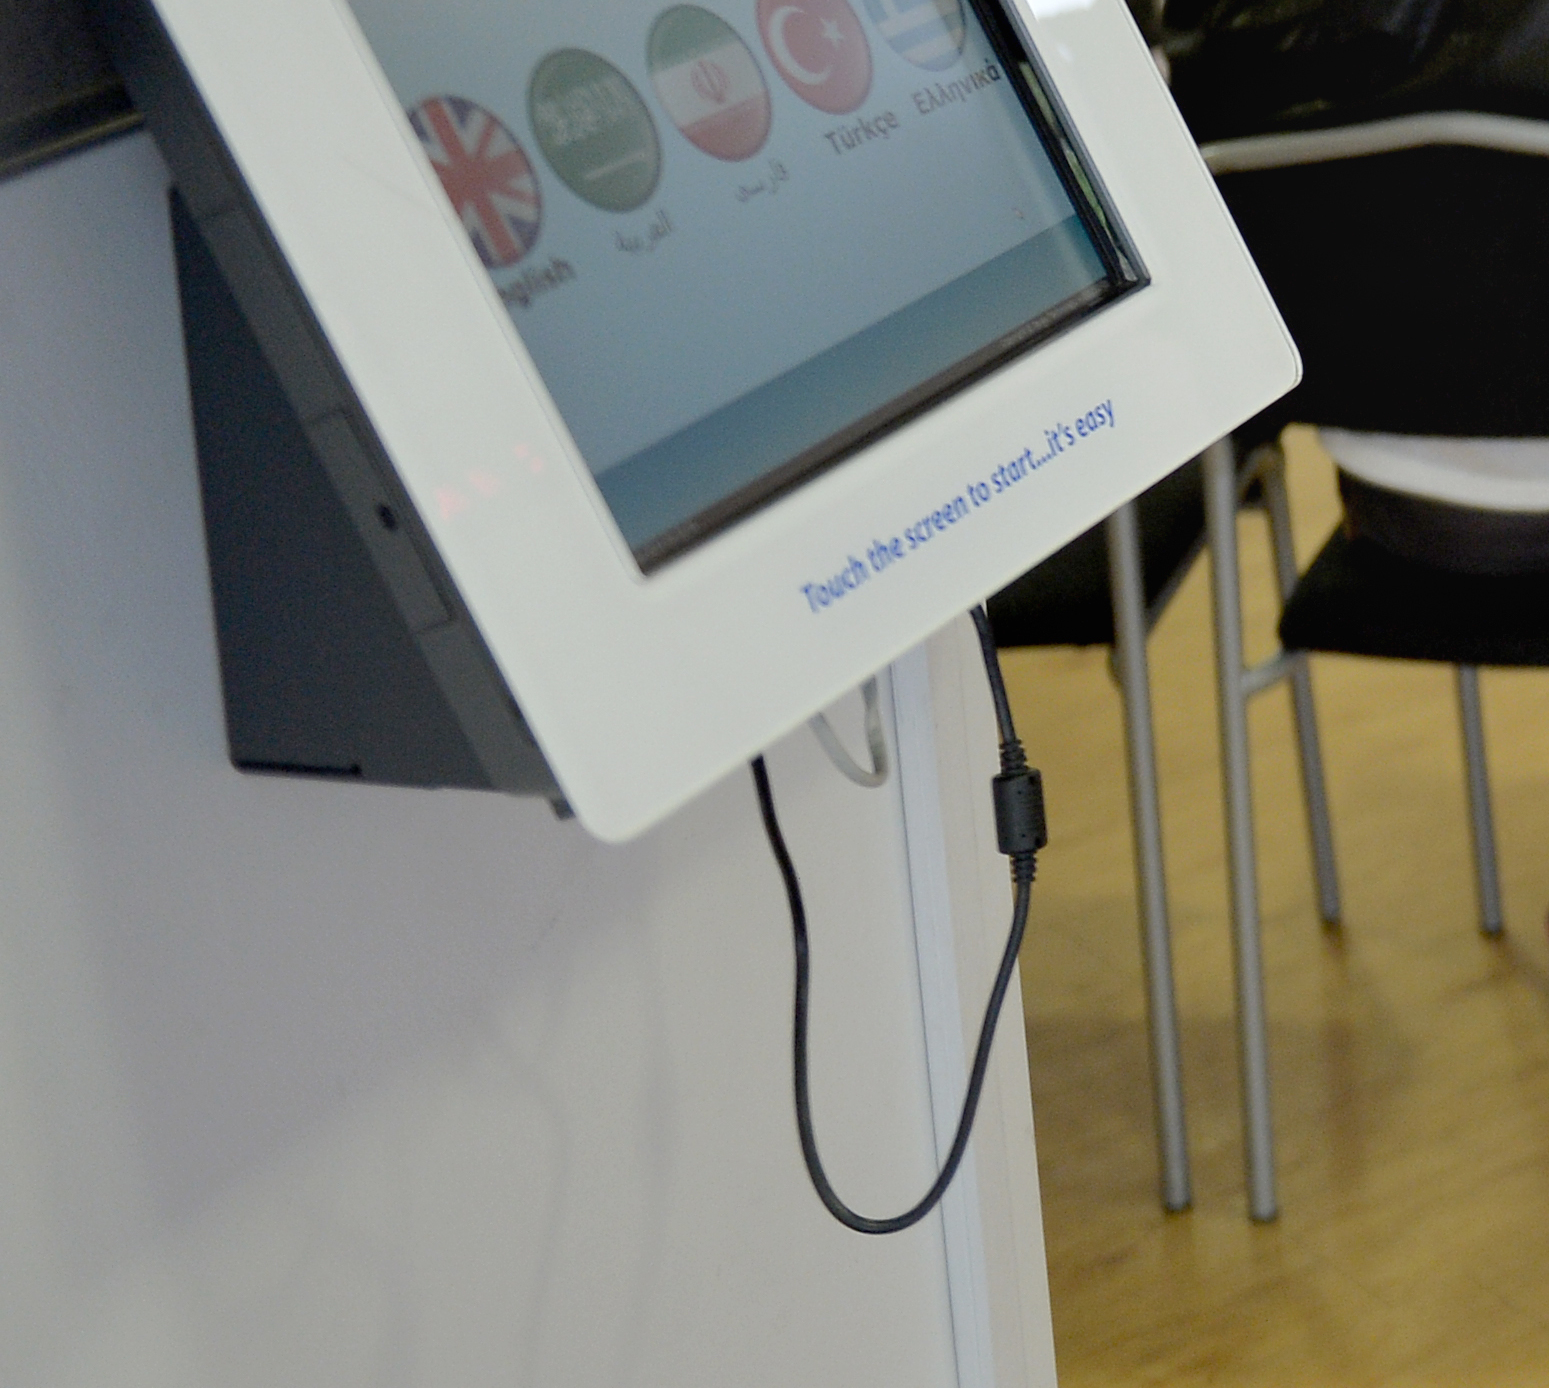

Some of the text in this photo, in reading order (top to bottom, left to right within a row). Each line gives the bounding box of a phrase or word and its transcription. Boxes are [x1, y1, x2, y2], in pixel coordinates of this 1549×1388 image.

[824, 111, 899, 155] Türkçe
[801, 556, 869, 612] Touch
[867, 538, 906, 572] the
[904, 496, 969, 550] screen
[967, 482, 991, 507] to
[1075, 399, 1116, 439] easy
